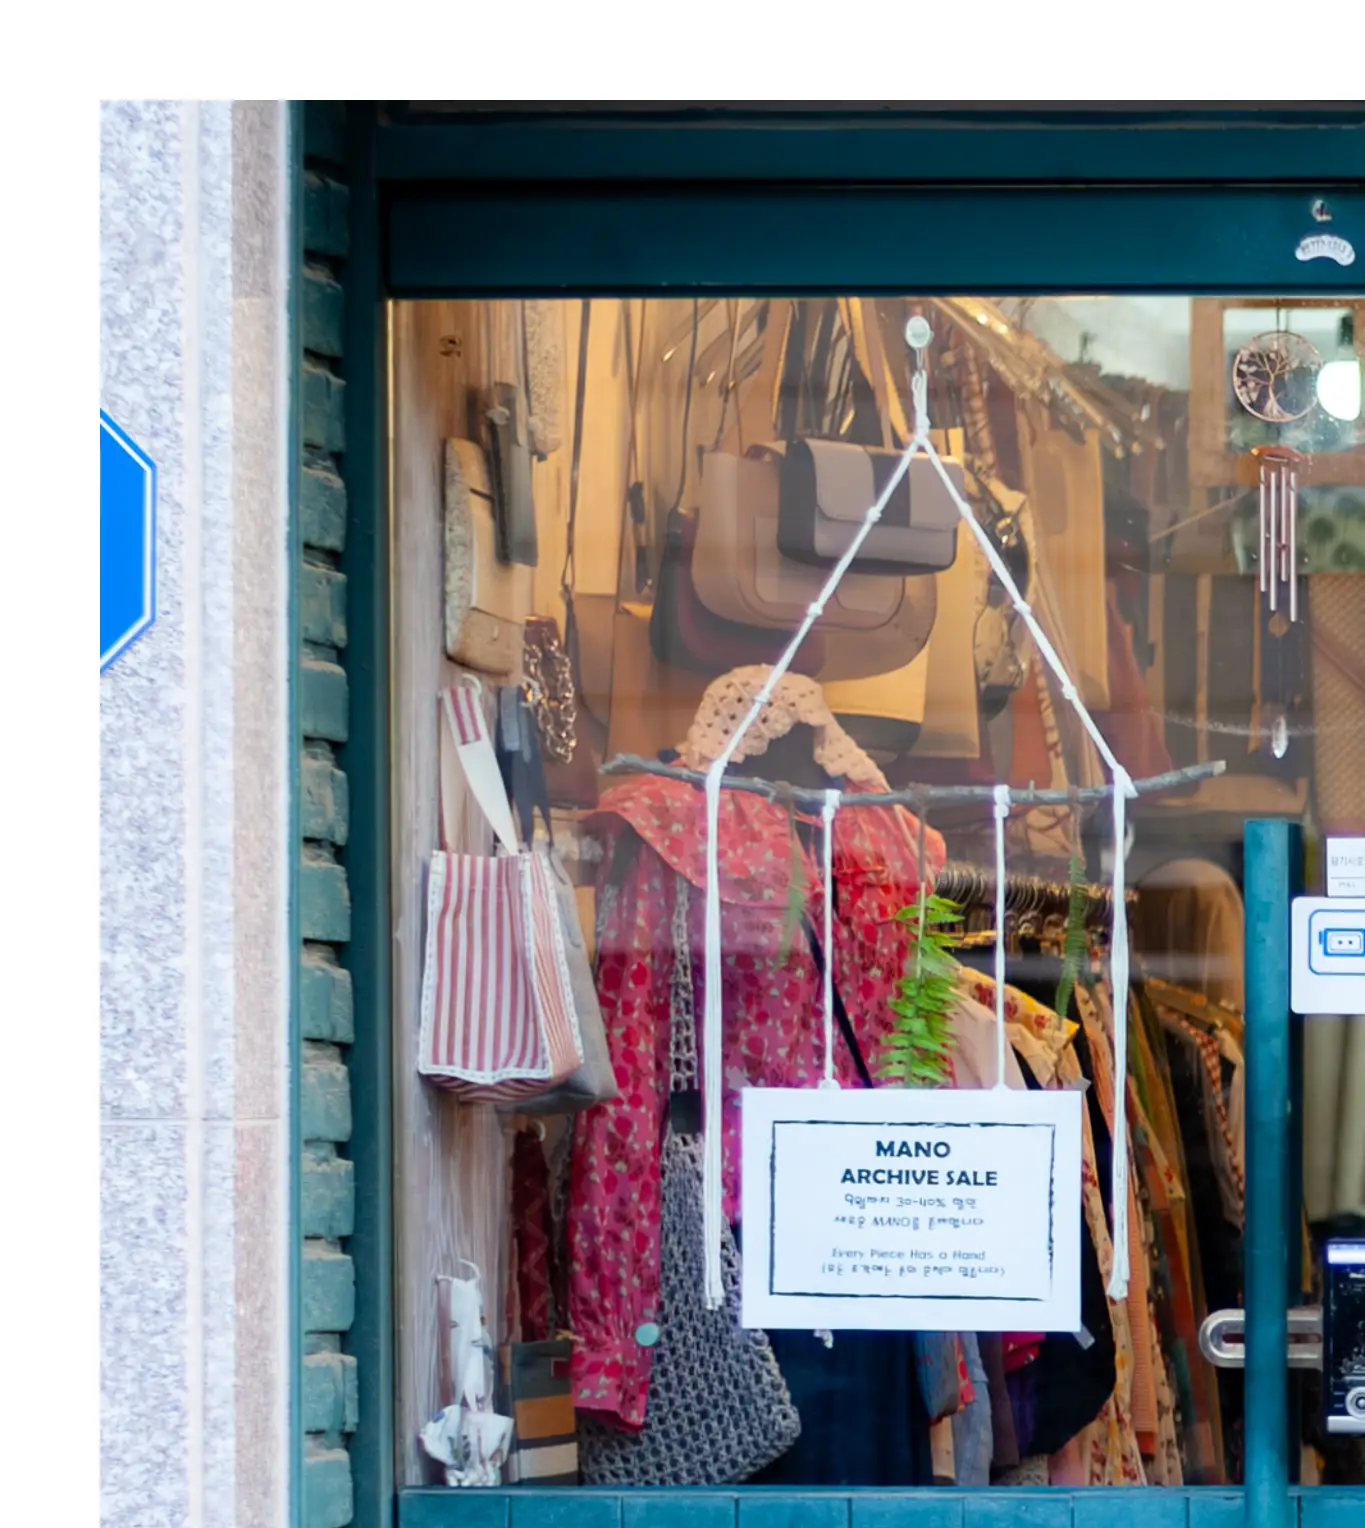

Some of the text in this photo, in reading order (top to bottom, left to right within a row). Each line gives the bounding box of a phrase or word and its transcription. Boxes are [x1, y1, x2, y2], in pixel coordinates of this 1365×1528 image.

[875, 1140, 951, 1158] MANO
[840, 1168, 998, 1187] ARCHIVE SALE
[832, 1248, 986, 1261] Every Piece Has a Hand
